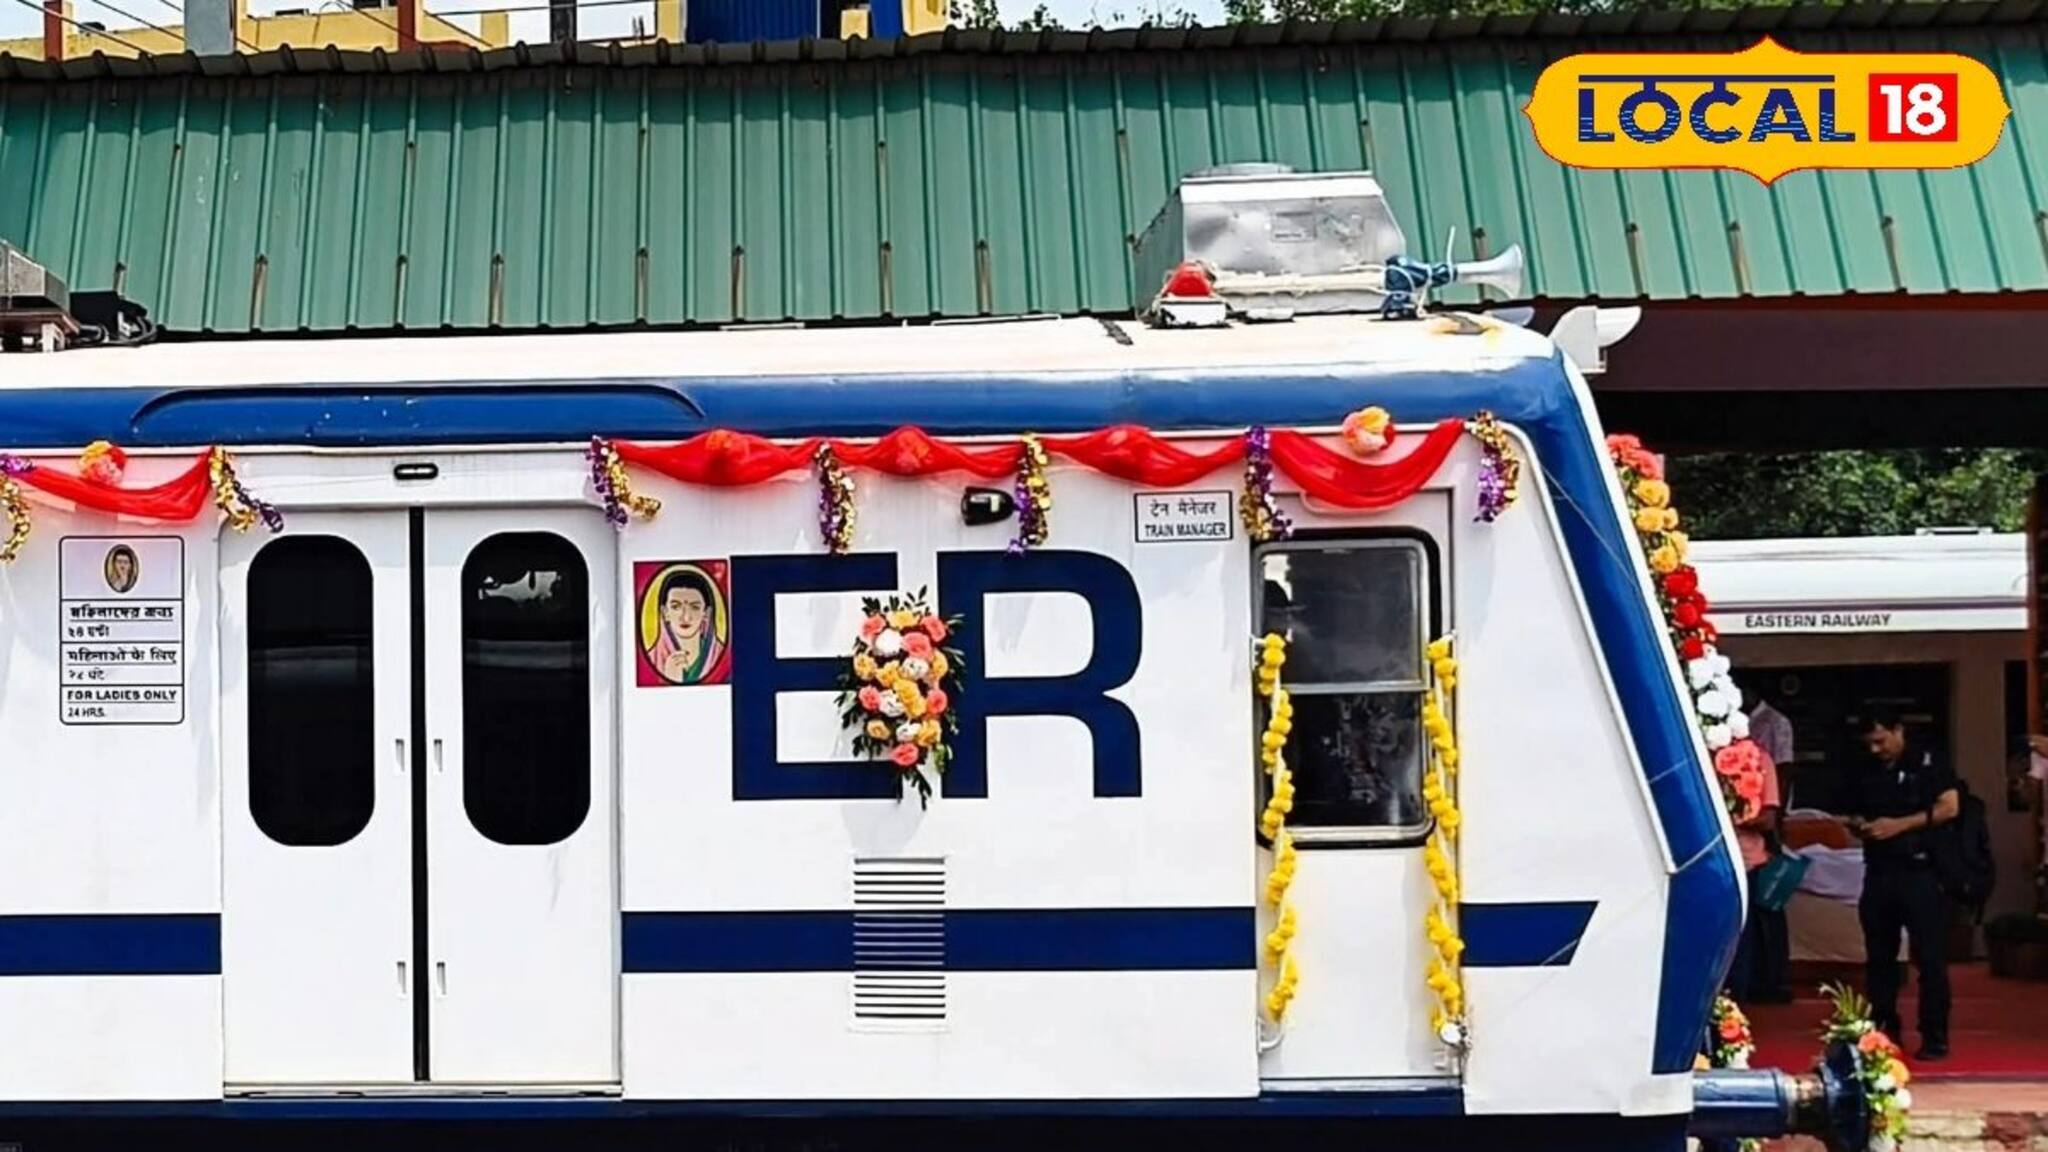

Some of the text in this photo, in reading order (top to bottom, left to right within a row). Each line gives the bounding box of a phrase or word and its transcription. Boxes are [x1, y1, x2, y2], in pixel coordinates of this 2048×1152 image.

[1144, 522, 1226, 537] TRAIN MANAGER
[1745, 613, 1891, 628] EASTERN RAILWAY
[730, 549, 1143, 801] ER
[67, 689, 177, 700] FOR LADIES ONLY
[68, 707, 81, 718] 24
